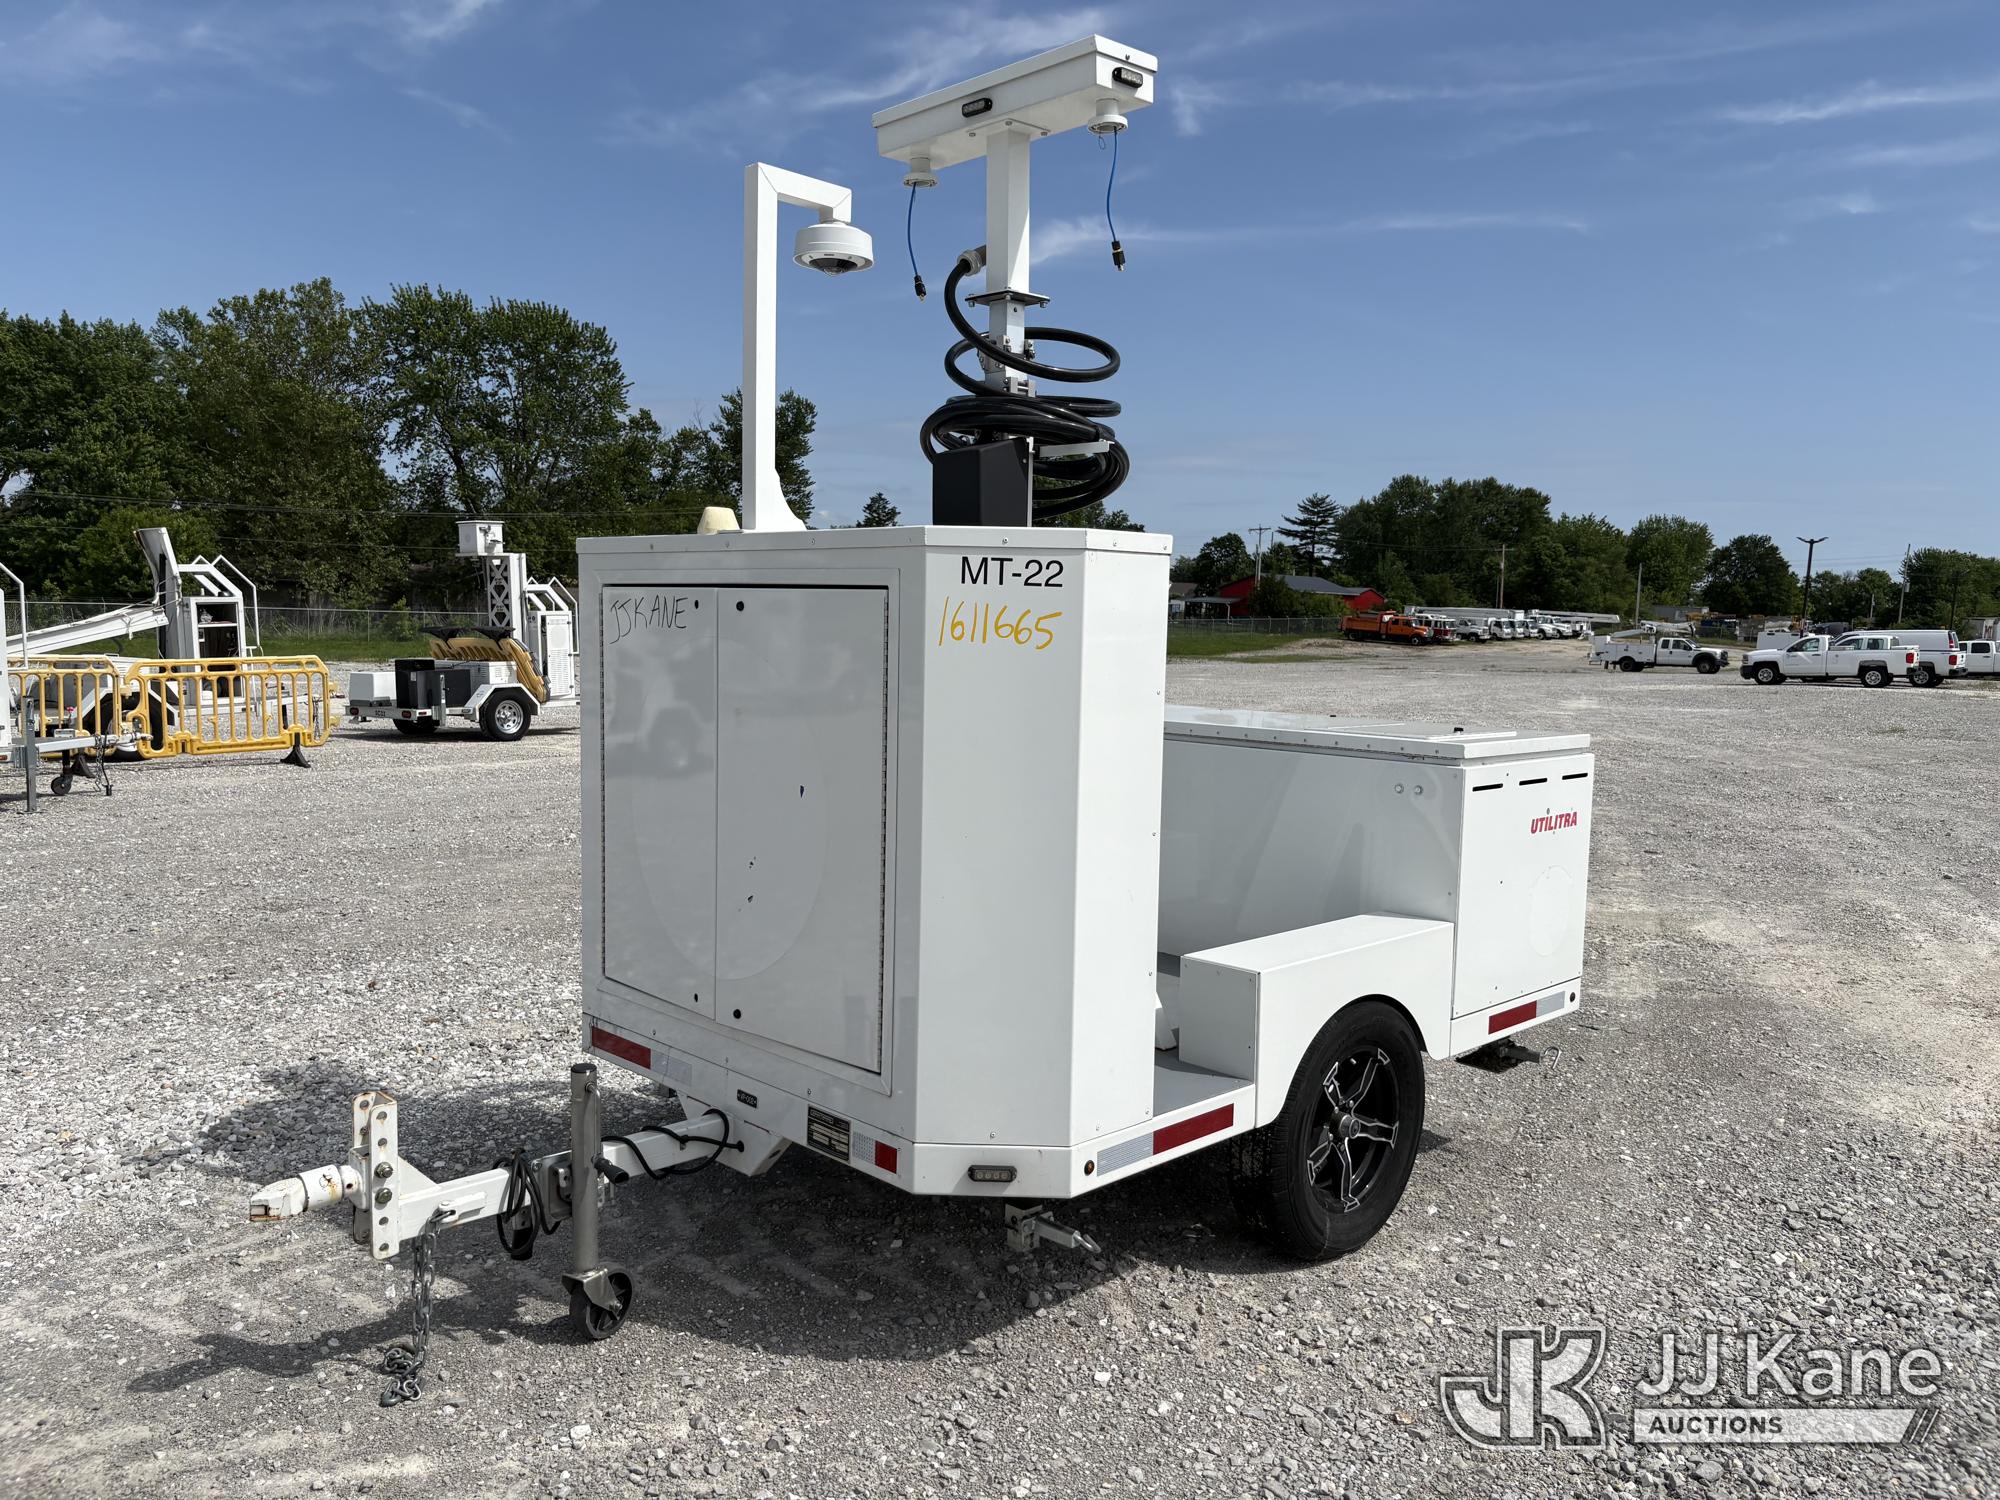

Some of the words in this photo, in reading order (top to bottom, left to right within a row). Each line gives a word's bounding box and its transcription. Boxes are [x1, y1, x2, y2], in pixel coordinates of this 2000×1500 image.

[961, 556, 1064, 587] MT-22
[939, 596, 1063, 650] 1611665
[1530, 811, 1577, 834] UTILITRA
